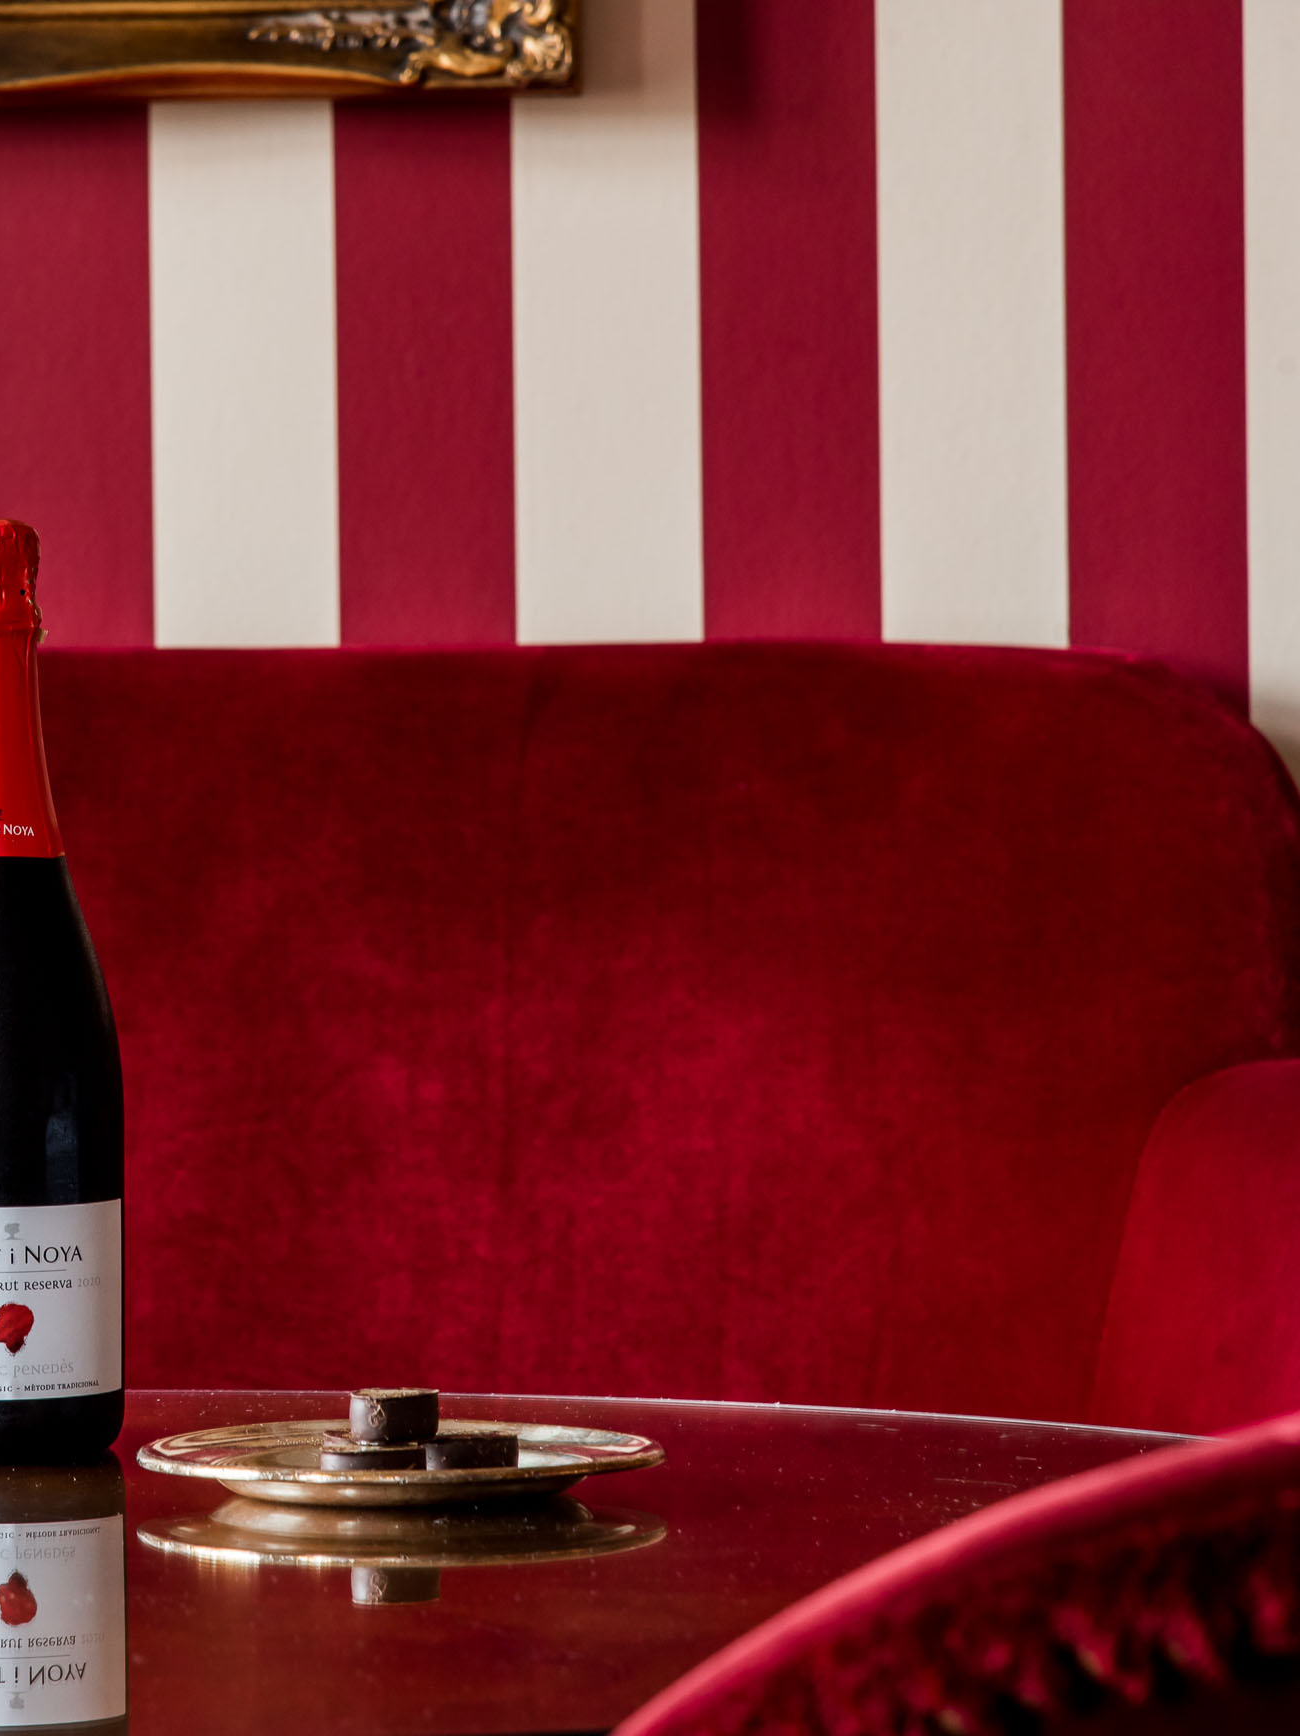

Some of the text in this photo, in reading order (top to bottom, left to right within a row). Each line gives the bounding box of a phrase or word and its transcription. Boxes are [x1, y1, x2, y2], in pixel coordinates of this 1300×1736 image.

[3, 824, 34, 836] NOYA
[10, 1248, 14, 1264] i
[25, 1245, 82, 1263] NOYA
[57, 1380, 99, 1391] TRADICIONAL
